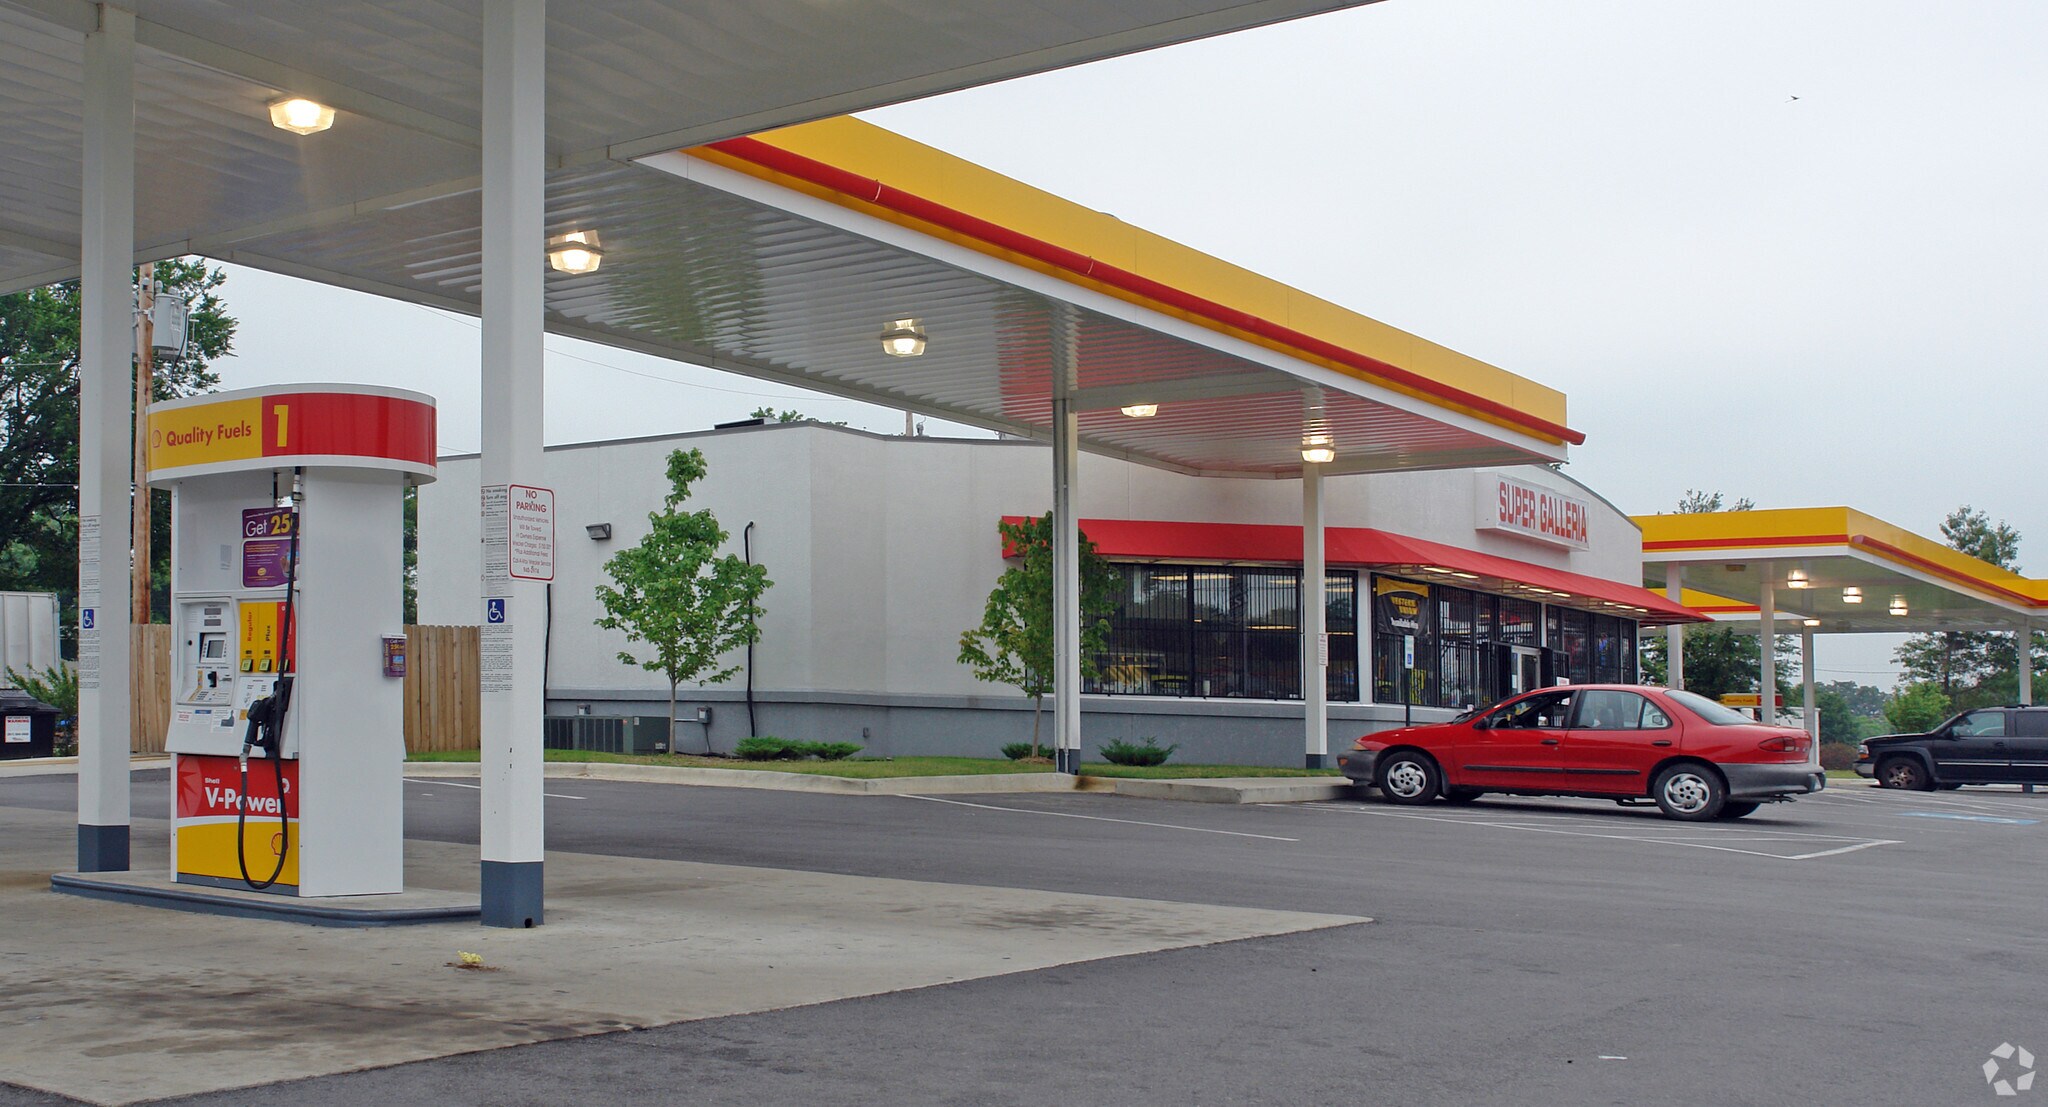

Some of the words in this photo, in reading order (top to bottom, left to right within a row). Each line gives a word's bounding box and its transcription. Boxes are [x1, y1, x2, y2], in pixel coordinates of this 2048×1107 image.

[166, 426, 214, 447] Quality
[217, 420, 252, 440] Fuels
[273, 404, 289, 448] 1
[525, 489, 538, 499] NO
[516, 501, 547, 513] PARKING
[1499, 481, 1536, 530] SUPER
[1540, 493, 1588, 543] GALLERIA
[246, 519, 268, 537] Get
[271, 513, 293, 535] 25
[1390, 596, 1418, 607] WESTERN
[204, 777, 220, 785] Shell
[204, 786, 283, 814] V-Power
